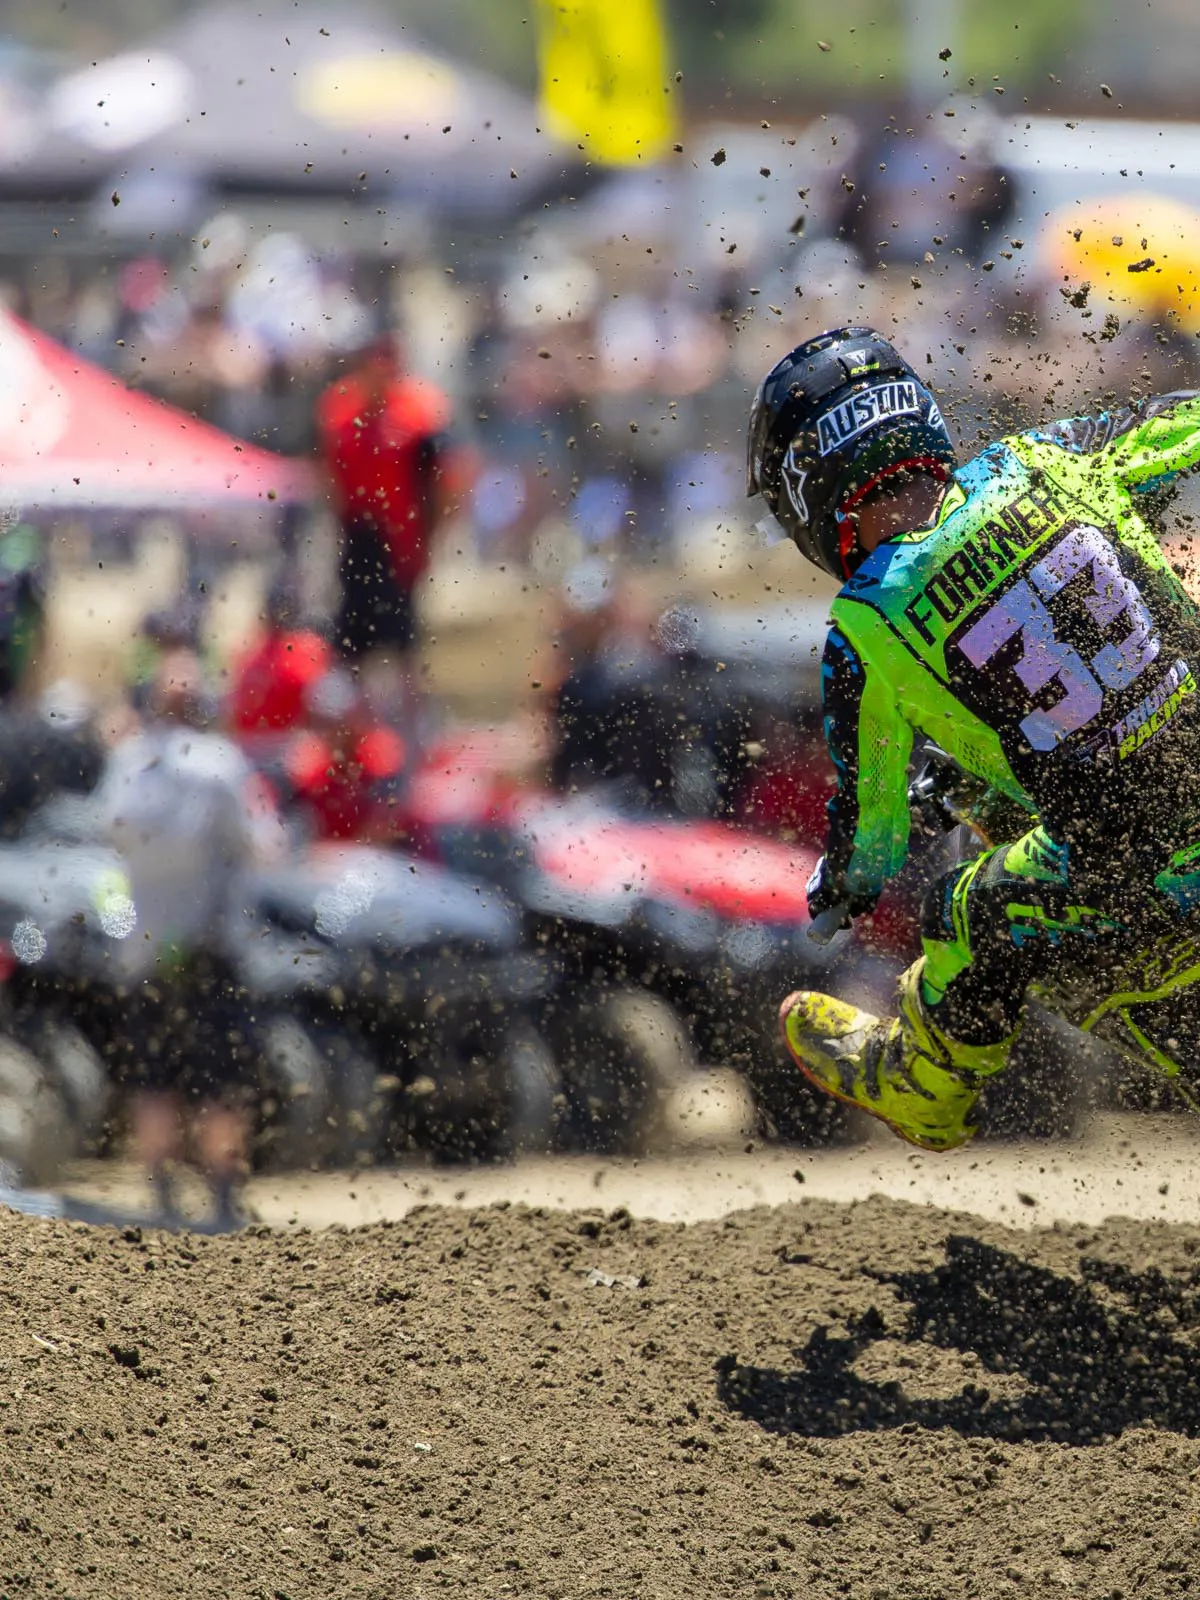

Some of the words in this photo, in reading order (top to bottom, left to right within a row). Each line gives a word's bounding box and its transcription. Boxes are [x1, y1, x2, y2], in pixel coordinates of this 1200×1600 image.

[818, 383, 917, 455] AUSTIN
[903, 488, 1068, 647] FORKNER
[957, 524, 1161, 752] 33
